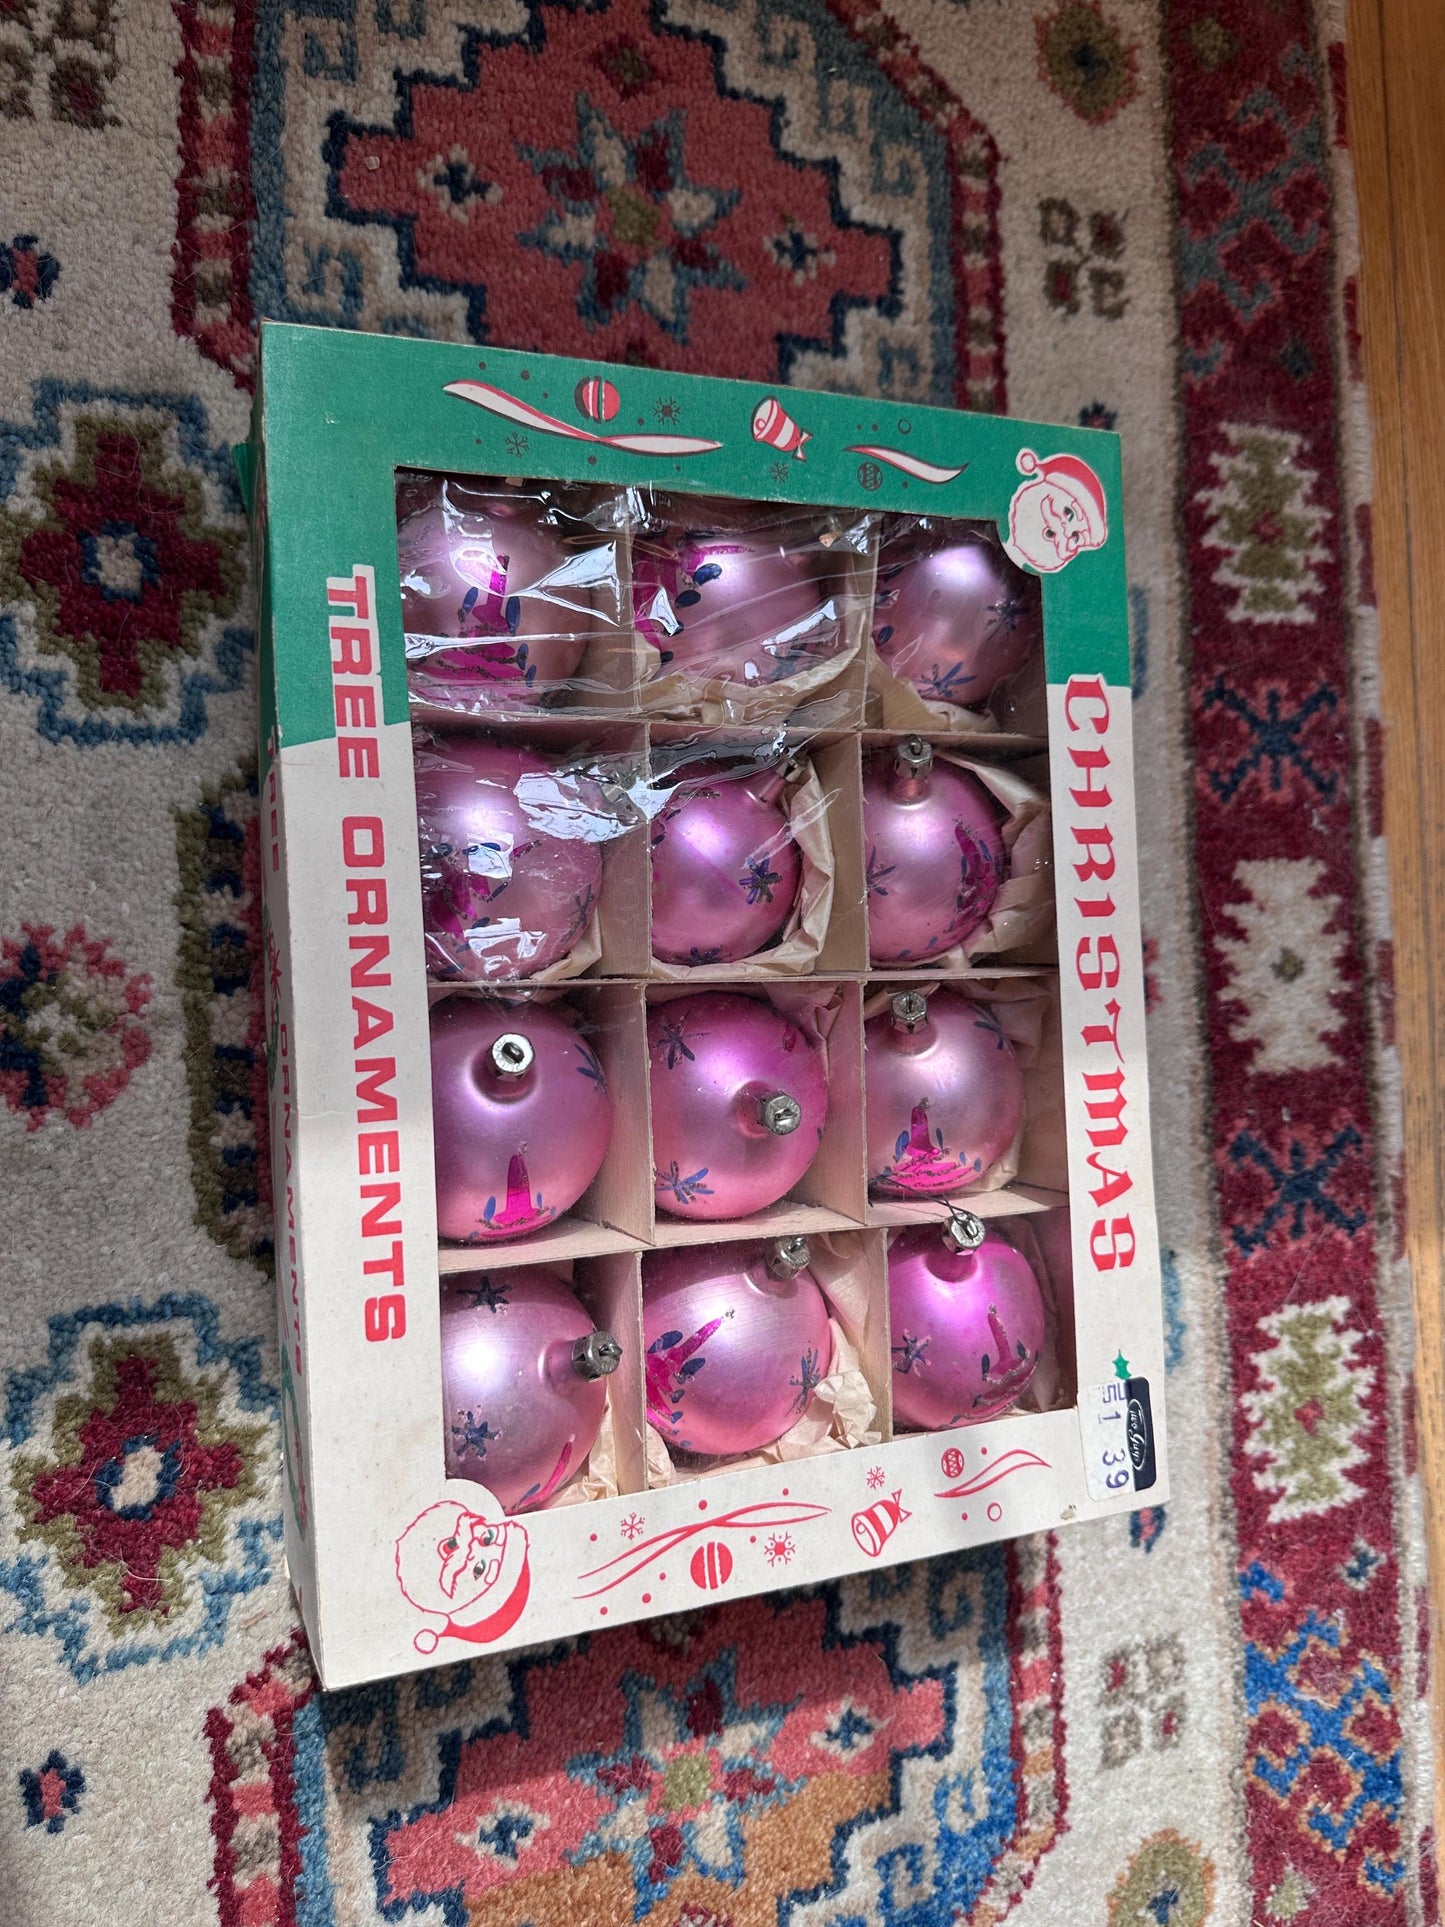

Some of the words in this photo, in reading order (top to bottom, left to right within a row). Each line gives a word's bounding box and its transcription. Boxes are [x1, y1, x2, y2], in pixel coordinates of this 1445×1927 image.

[327, 575, 381, 778] TREE
[267, 735, 280, 873] TREE
[280, 1023, 302, 1377] ORNAMENTS
[341, 816, 407, 1342] ORNAMENTS
[1063, 677, 1137, 1274] CHRISTMAS
